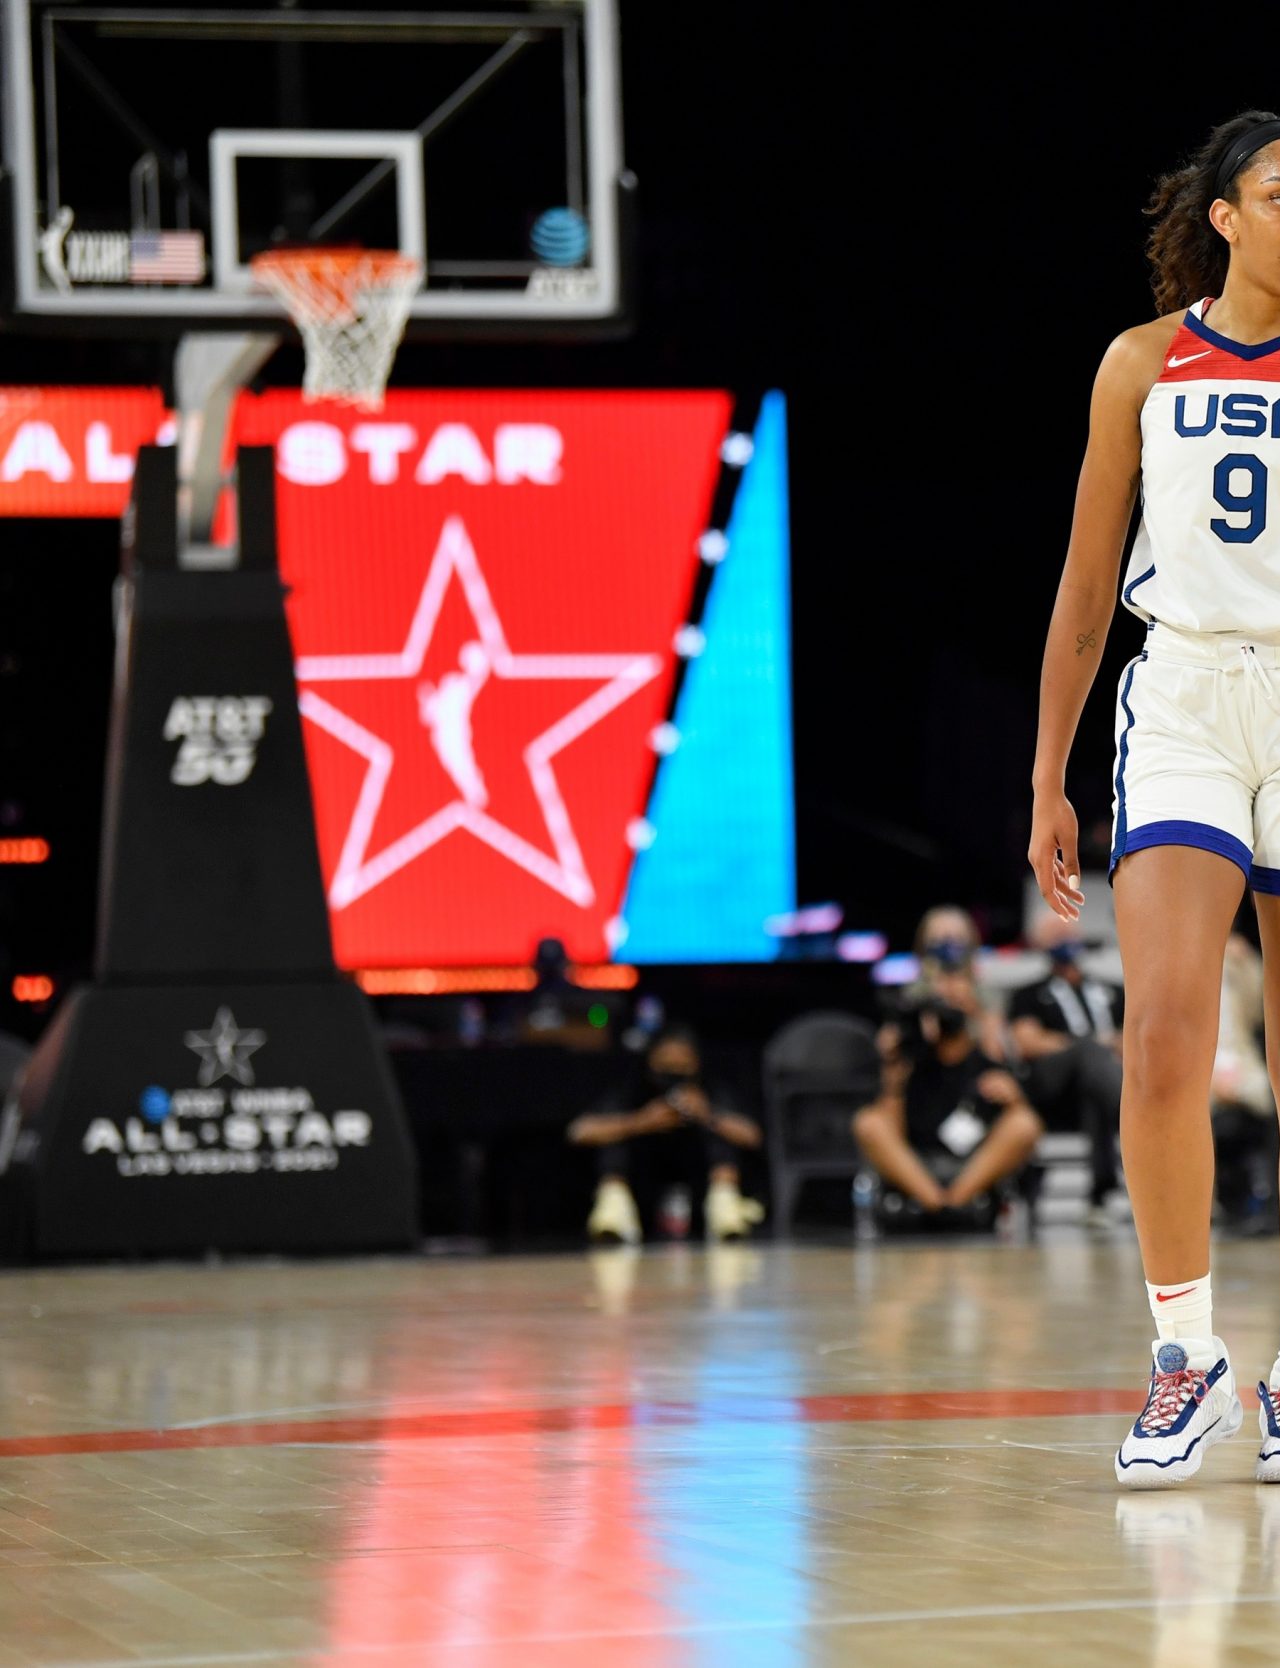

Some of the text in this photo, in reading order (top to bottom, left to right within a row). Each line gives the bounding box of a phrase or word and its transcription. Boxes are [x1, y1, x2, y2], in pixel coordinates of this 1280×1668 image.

[1, 420, 563, 485] AL STAR
[1210, 453, 1268, 543] 9
